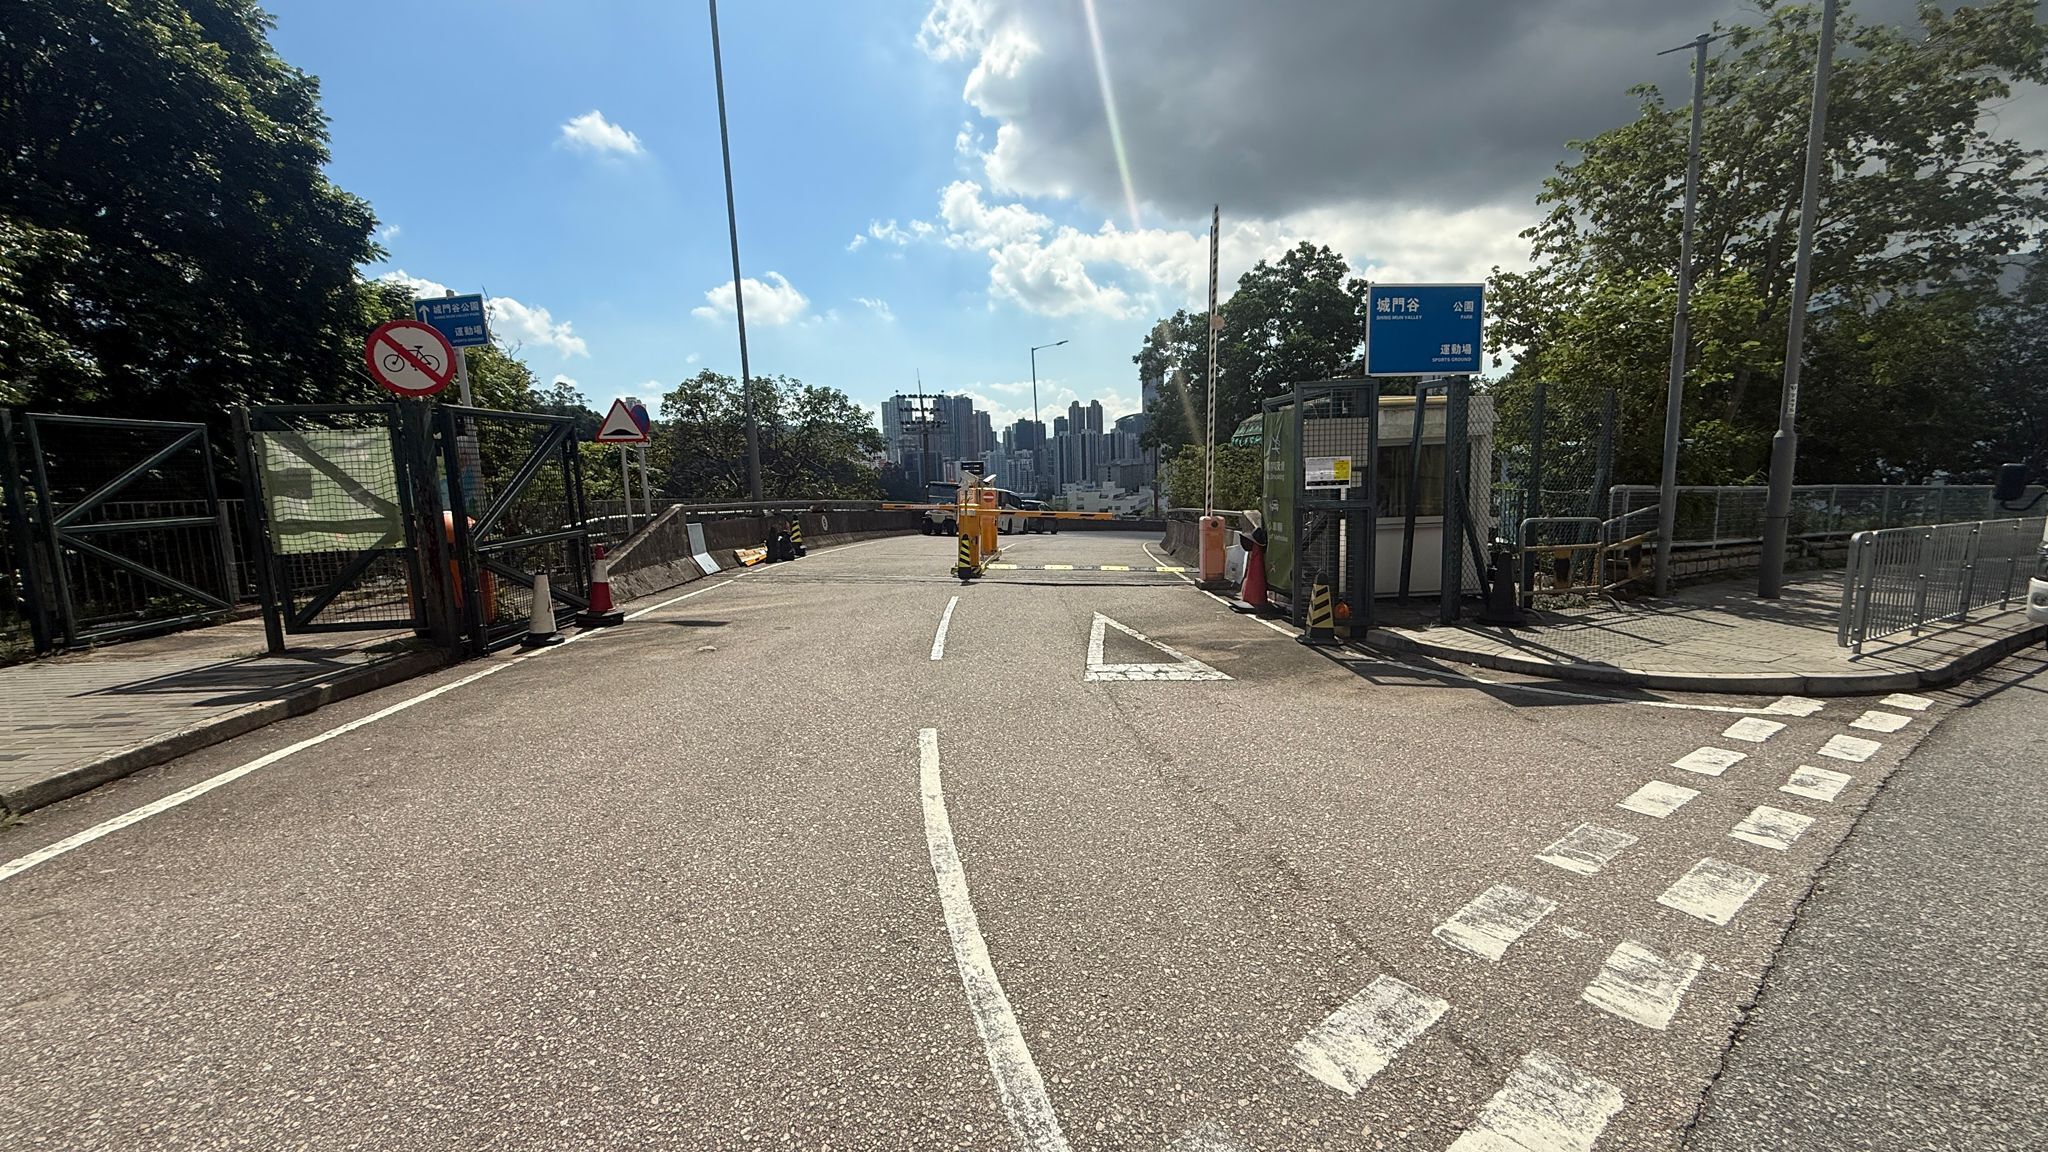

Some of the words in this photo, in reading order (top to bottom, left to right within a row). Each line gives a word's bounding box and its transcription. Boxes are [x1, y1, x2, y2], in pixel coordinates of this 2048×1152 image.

[433, 301, 479, 314] 城門谷公園
[1376, 297, 1420, 312] 城門谷
[1453, 301, 1474, 312] 公園
[455, 325, 482, 336] 運動場
[1440, 343, 1472, 355] 運動場
